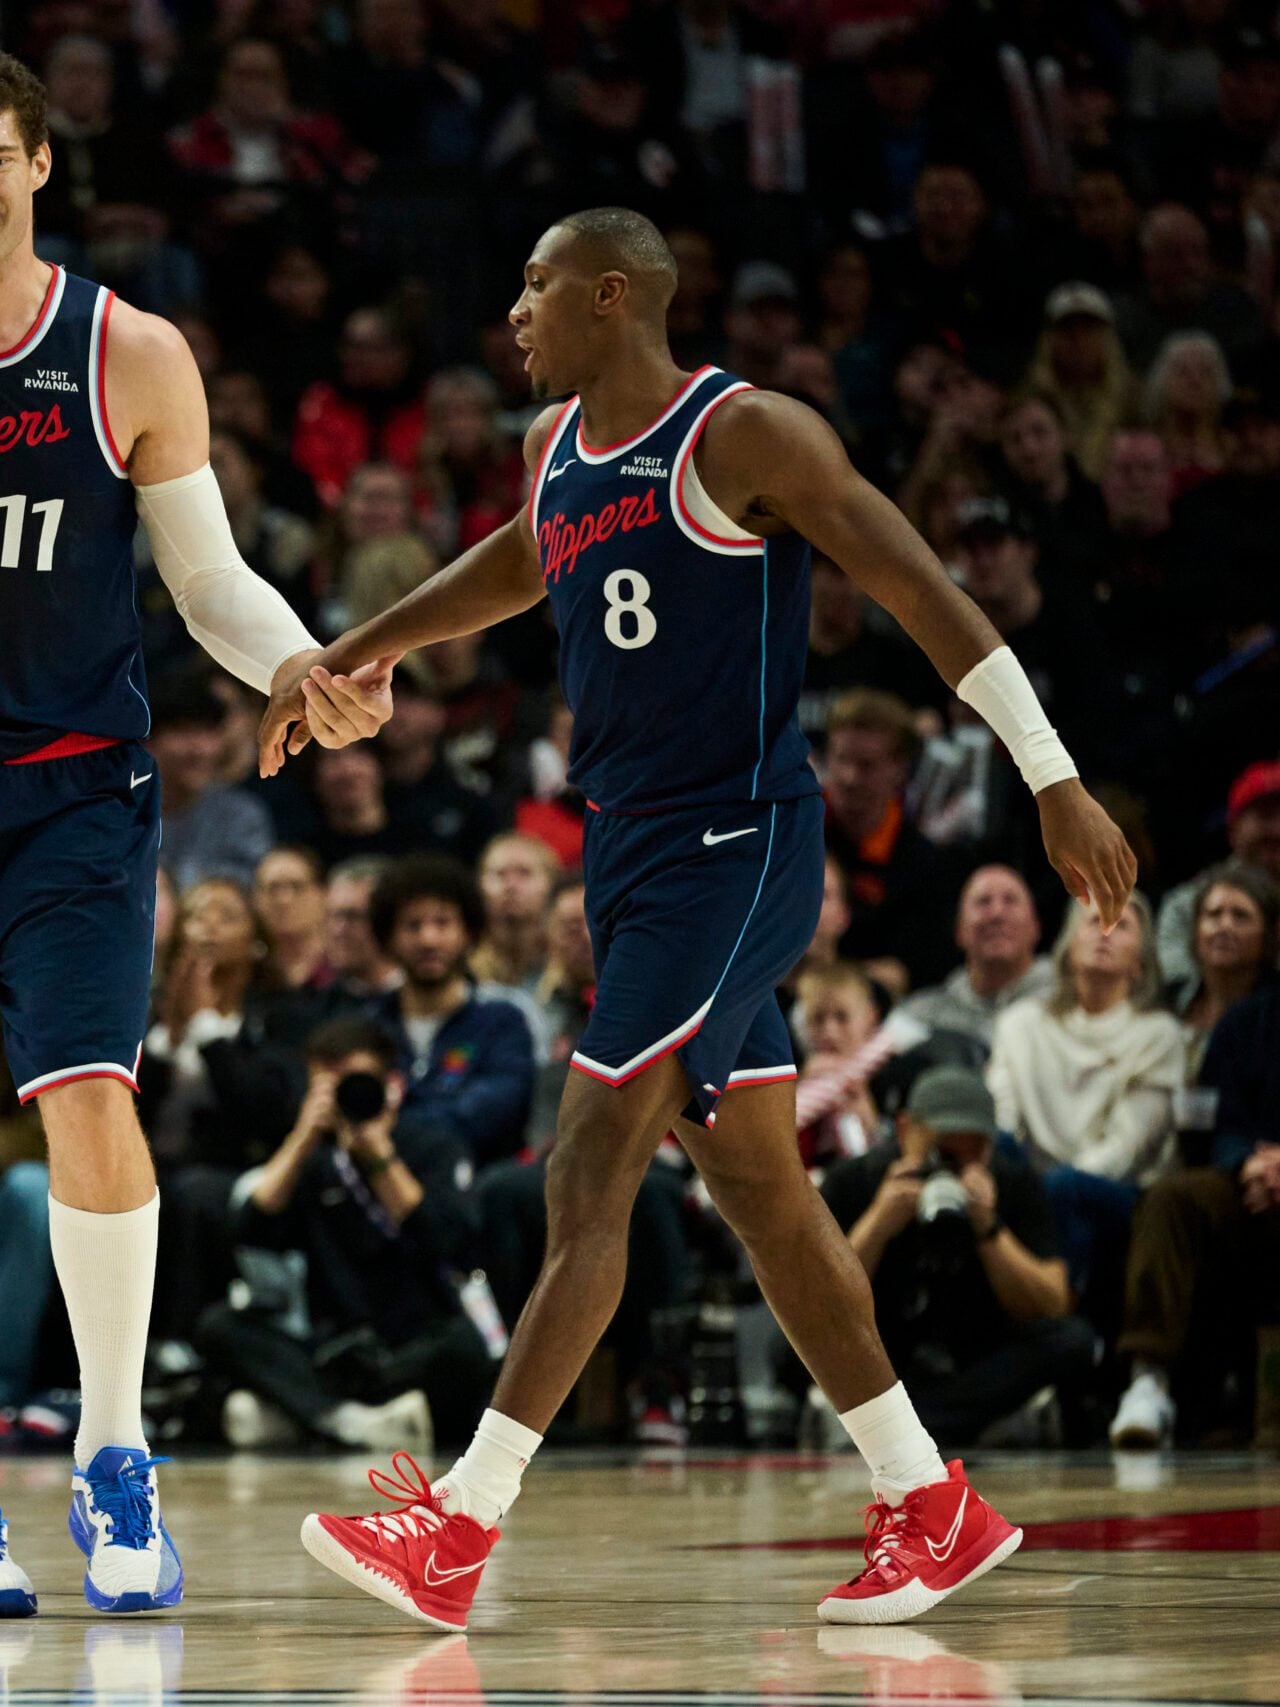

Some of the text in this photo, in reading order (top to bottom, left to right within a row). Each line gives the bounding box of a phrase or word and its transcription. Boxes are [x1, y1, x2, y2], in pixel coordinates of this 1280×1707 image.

[36, 369, 69, 381] VISIT
[24, 378, 79, 392] RWANDA
[634, 456, 663, 468] VISIT
[620, 465, 668, 478] RWANDA
[538, 487, 662, 585] Clippers
[603, 568, 658, 650] 8
